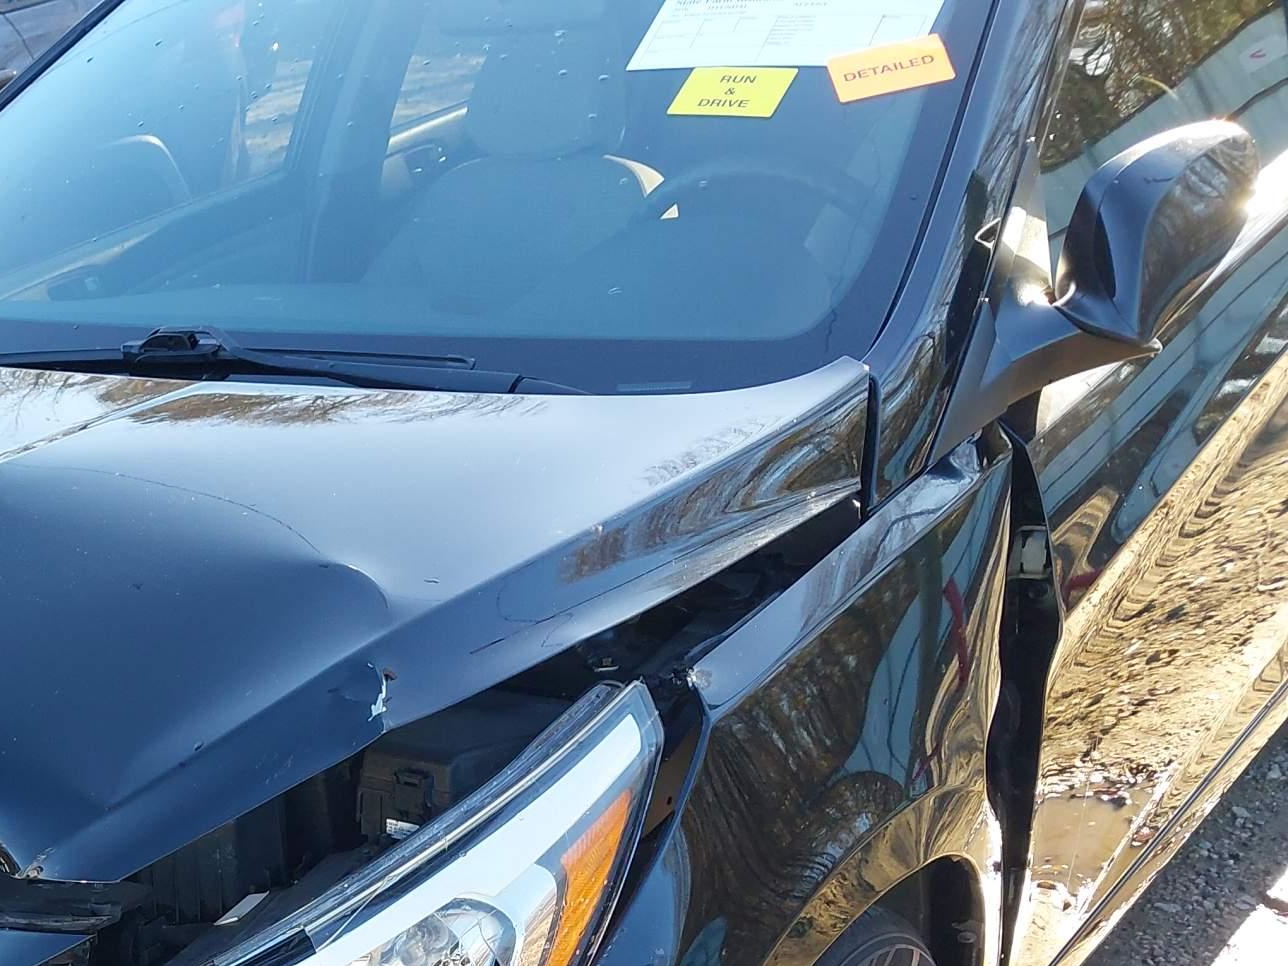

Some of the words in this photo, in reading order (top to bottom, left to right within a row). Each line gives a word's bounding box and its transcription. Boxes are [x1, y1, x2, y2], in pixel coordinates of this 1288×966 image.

[843, 55, 934, 82] DETAILED
[720, 75, 756, 84] RUN
[725, 87, 736, 96] &
[698, 99, 750, 108] DRIVE
